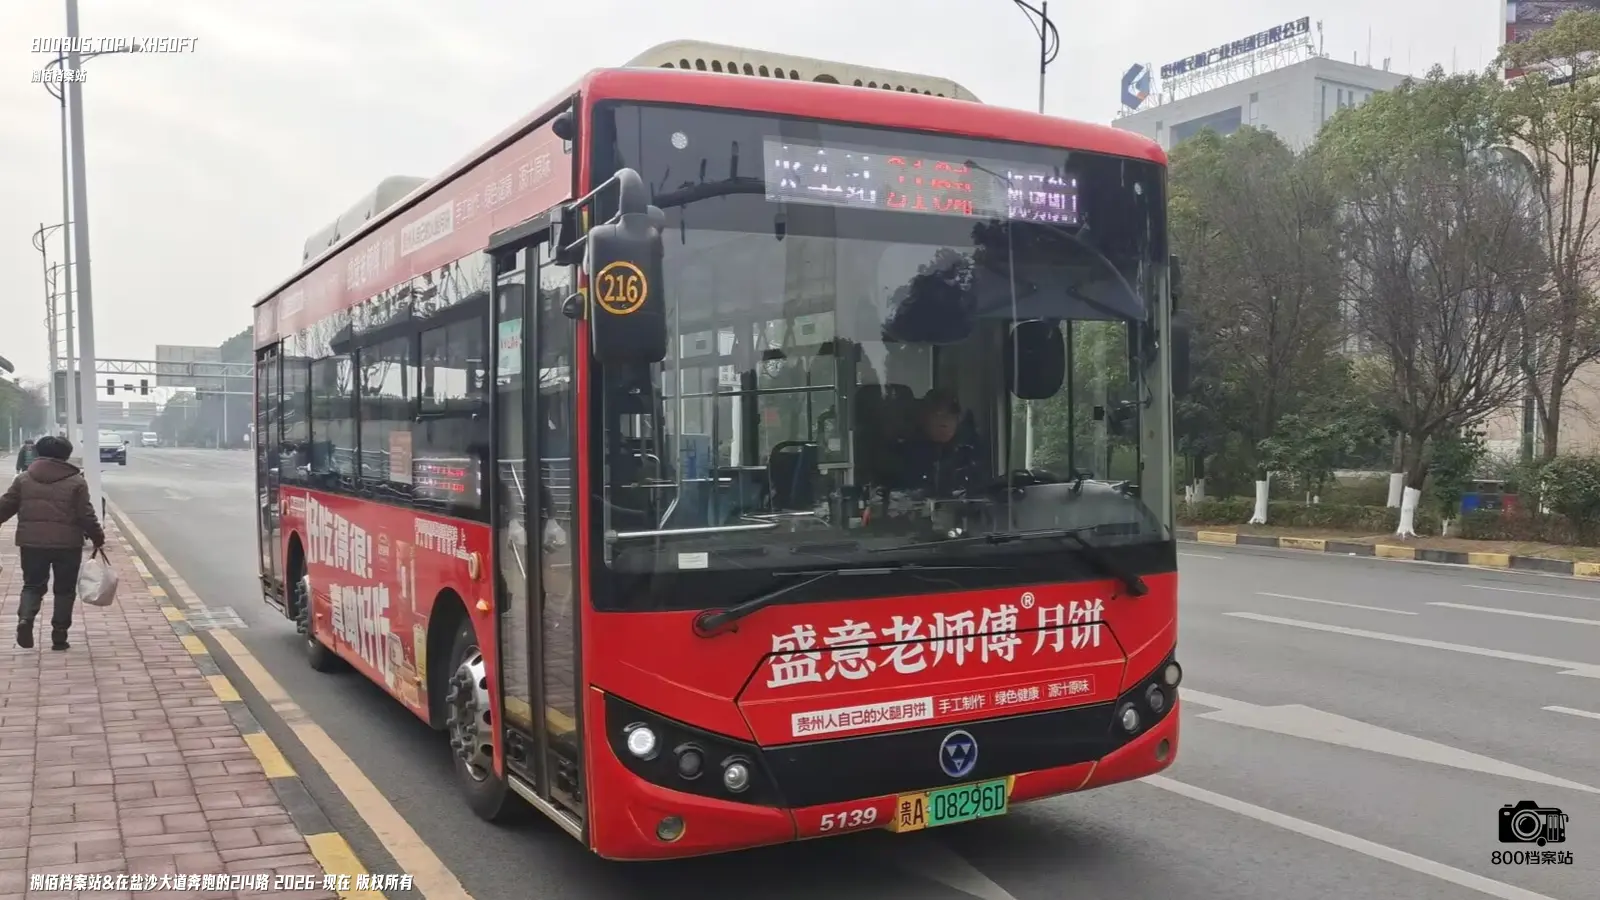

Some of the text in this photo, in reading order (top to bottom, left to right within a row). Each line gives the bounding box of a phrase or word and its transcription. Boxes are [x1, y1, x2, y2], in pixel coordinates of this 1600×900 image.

[603, 273, 638, 303] 216
[796, 679, 1091, 733] 贵州人自己的火腿月饼 手工制作 绿色健康 源汁原味
[819, 806, 878, 832] 5139
